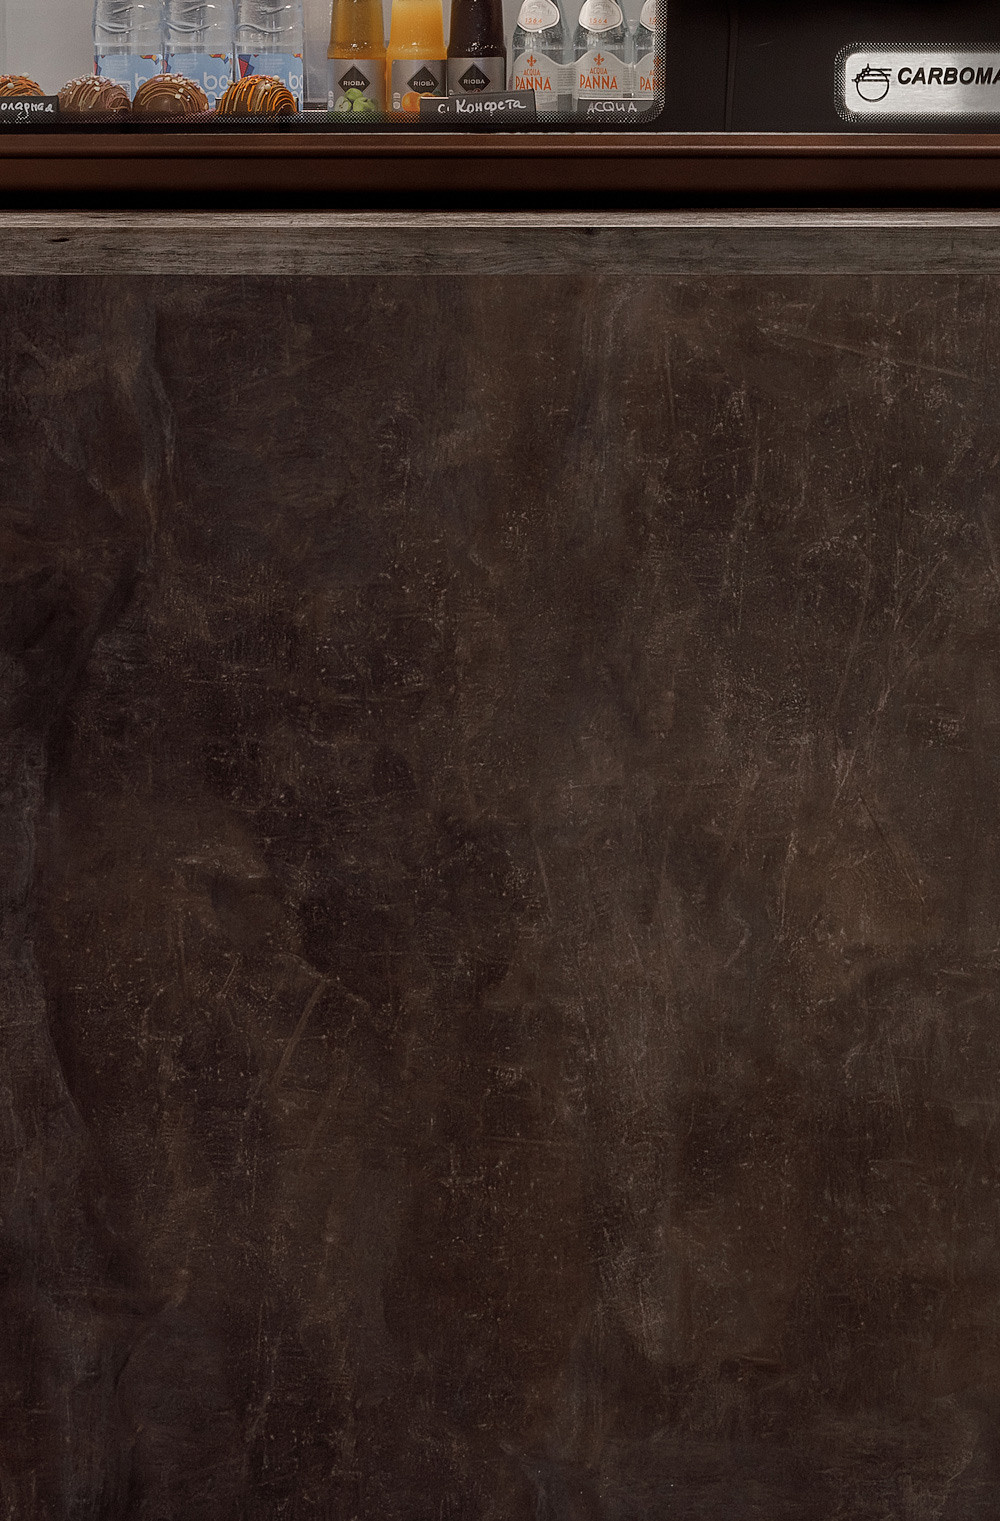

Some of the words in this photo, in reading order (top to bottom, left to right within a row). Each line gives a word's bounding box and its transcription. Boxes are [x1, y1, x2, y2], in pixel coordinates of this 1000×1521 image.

[589, 67, 608, 75] ACQUA
[515, 76, 552, 91] PANNA
[579, 74, 618, 90] PANNA
[455, 99, 527, 116] Конфета
